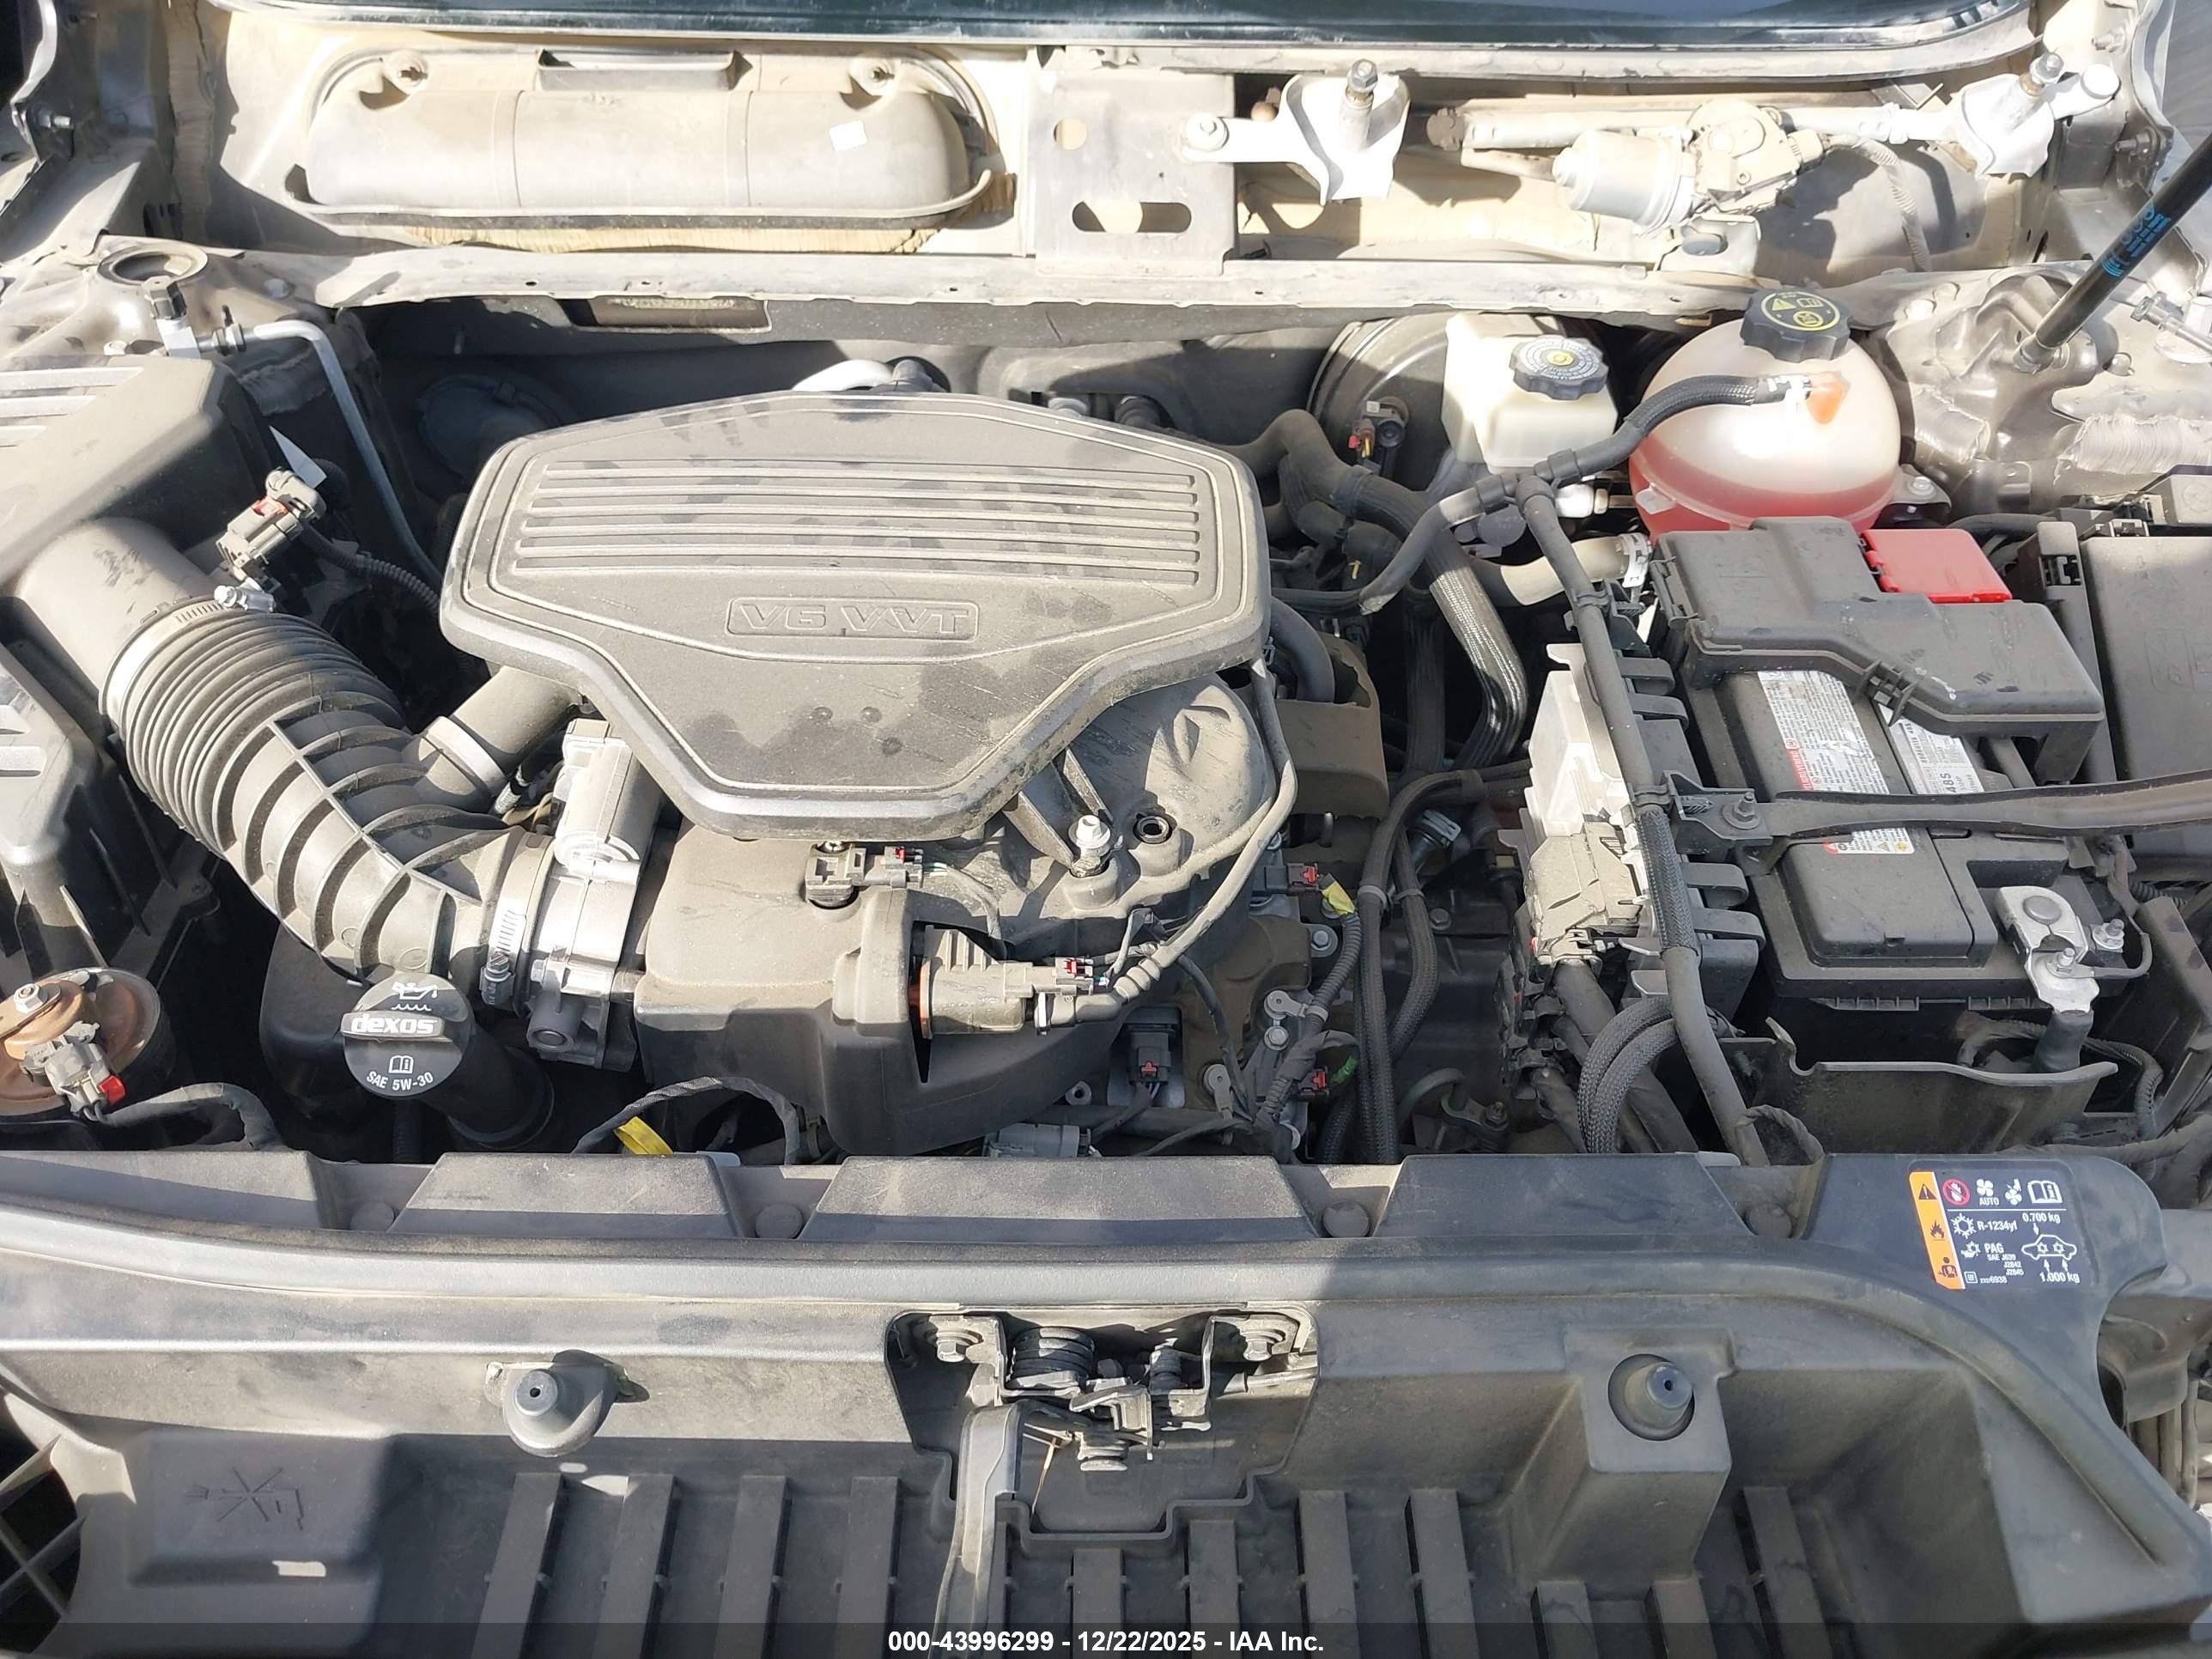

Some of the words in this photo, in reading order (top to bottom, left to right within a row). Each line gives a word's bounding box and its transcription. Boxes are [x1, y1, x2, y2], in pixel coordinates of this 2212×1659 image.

[740, 604, 827, 630] V6
[840, 605, 969, 634] VVT
[350, 1013, 439, 1034] dexos
[366, 1071, 389, 1089] SAE
[392, 1072, 434, 1091] 5W-30
[1979, 1197, 1999, 1206] AUTO
[2021, 1212, 2047, 1222] 0.700
[2047, 1212, 2061, 1224] kg
[1984, 1243, 2004, 1254] PAG
[2039, 1272, 2066, 1282] 1.000
[2066, 1272, 2080, 1284] kg
